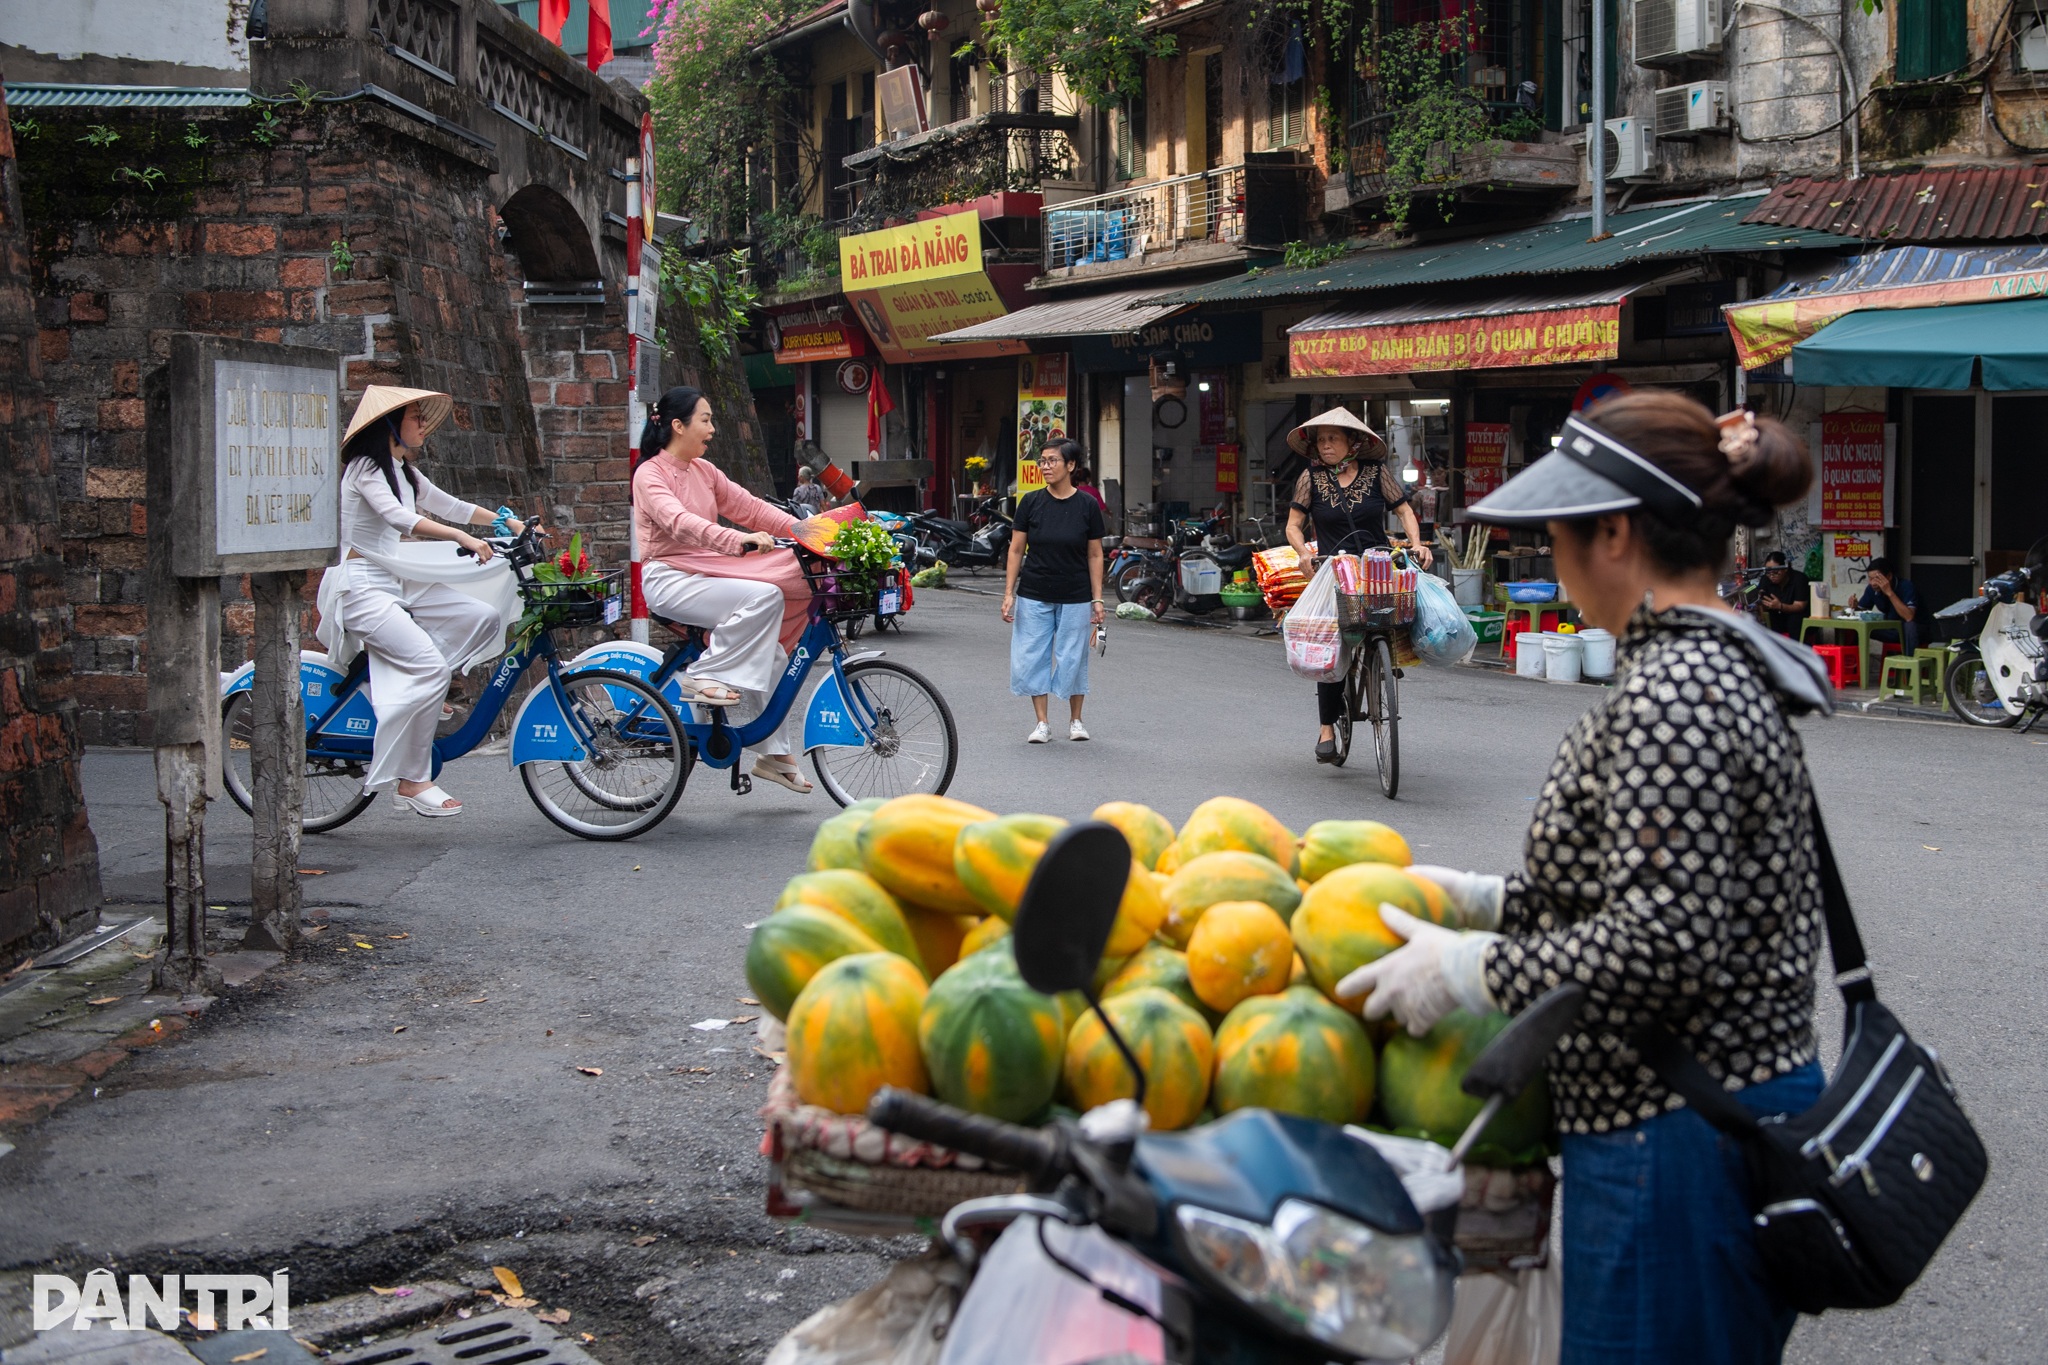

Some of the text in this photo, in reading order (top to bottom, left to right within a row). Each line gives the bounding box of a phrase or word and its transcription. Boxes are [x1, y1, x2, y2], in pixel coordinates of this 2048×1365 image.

[850, 225, 968, 279] BÀ TRAI ĐÀ NẴNG
[1988, 274, 2048, 296] MIN
[892, 291, 924, 313] QUÁN
[919, 288, 939, 309] BÀ
[934, 290, 961, 307] TRAI
[985, 291, 992, 301] 2
[783, 335, 803, 349] CURRY
[803, 332, 823, 346] HOUSE
[1294, 332, 1336, 355] TUYẾT
[1371, 336, 1413, 361] BÁNH
[1416, 332, 1449, 357] RÁN
[1475, 327, 1487, 353] Ô
[1491, 327, 1537, 354] QUAN
[1543, 315, 1619, 349] CHƯỞNG
[262, 389, 288, 429] QUAN
[1468, 427, 1493, 444] TUYẾT
[1841, 419, 1881, 435] Xuân
[229, 445, 242, 476] DI
[279, 446, 308, 480] LỊCH
[1824, 436, 1882, 466] BÚN ỐC NGUỘI
[1022, 464, 1043, 484] NEM
[1824, 464, 1881, 487] Ô QUAN CHƯỞNG
[1835, 489, 1840, 500] 1
[1842, 491, 1860, 500] HÀNG
[1862, 490, 1881, 500] CHIẾU
[493, 656, 521, 688] TNGO
[787, 647, 811, 677] TNGO
[819, 710, 840, 724] TN
[532, 724, 558, 738] TN
